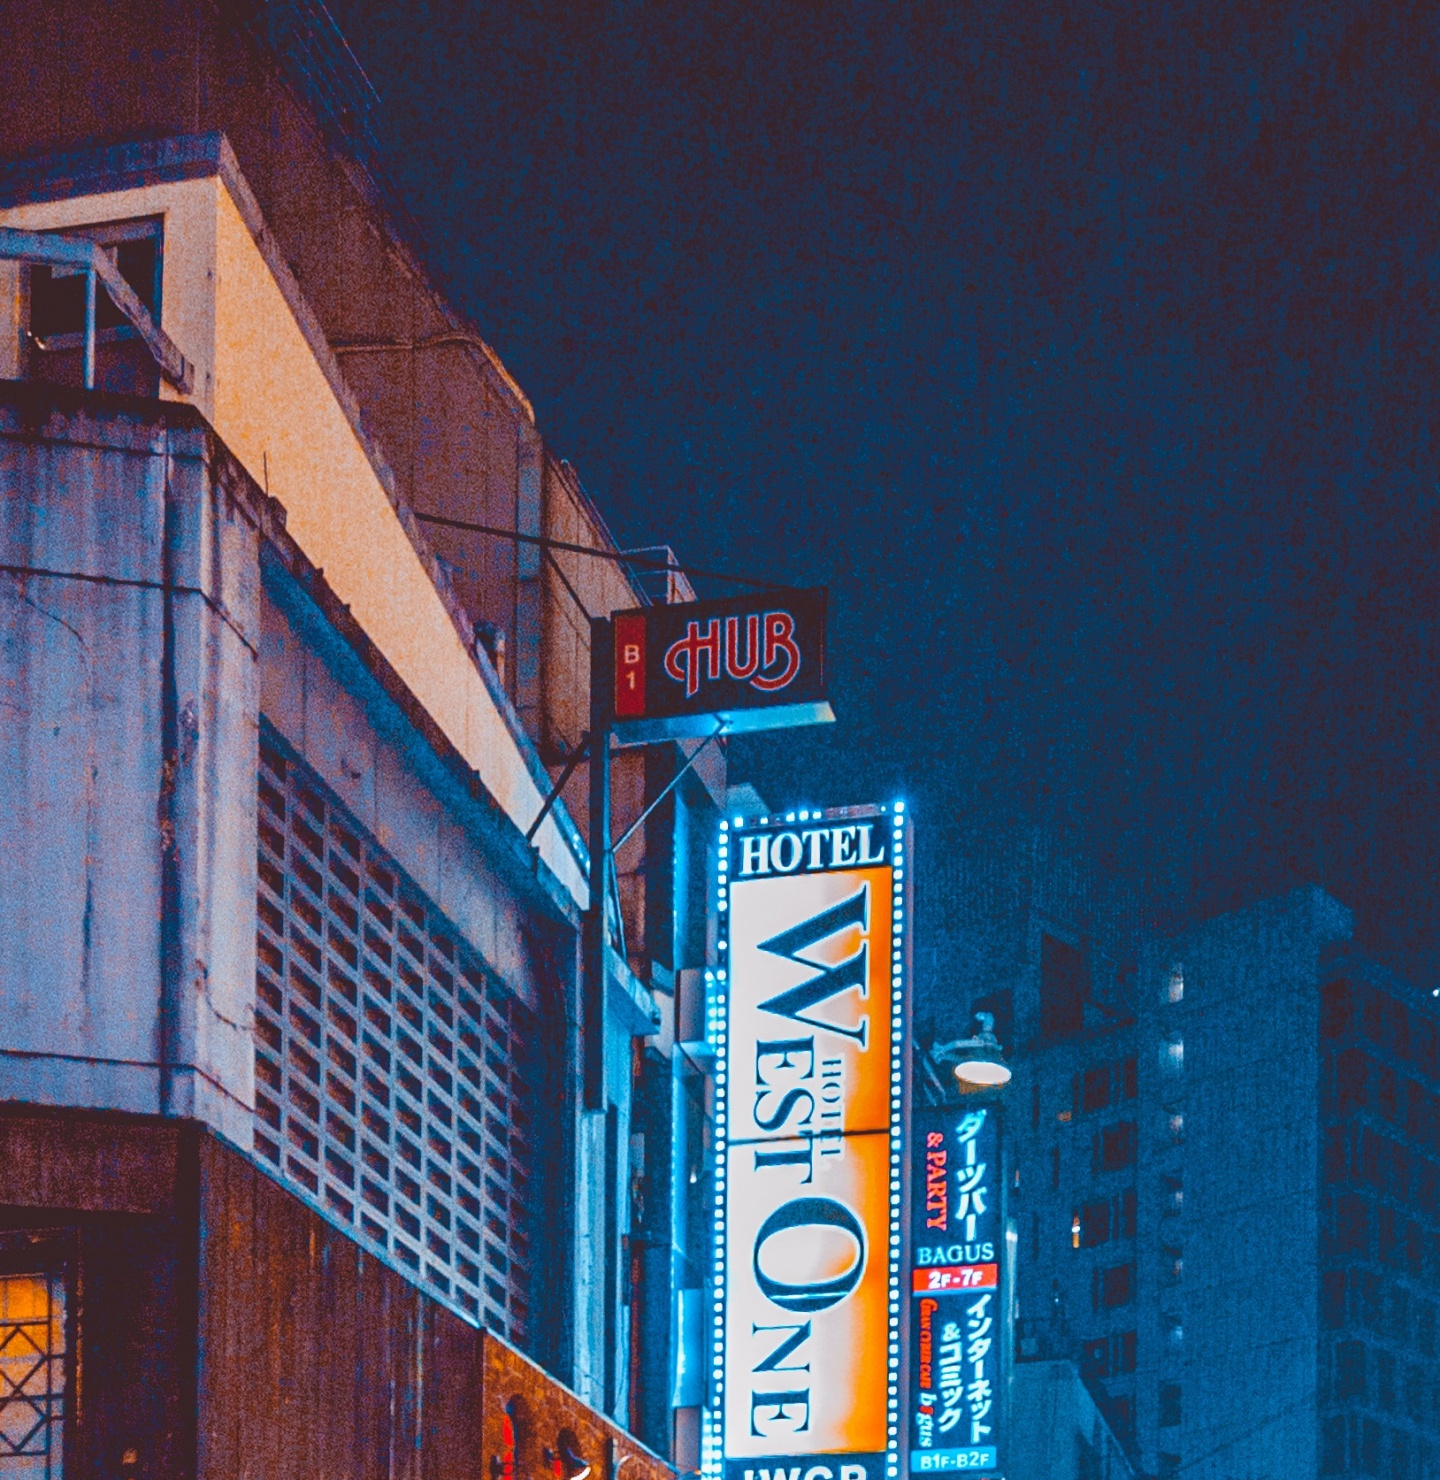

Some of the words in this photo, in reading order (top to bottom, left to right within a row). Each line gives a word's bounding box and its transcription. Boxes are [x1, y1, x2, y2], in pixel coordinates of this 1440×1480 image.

[624, 644, 641, 690] B1
[664, 611, 801, 698] HUB
[739, 824, 884, 876] HOTEL
[926, 1132, 943, 1149] &
[926, 1150, 947, 1232] PARTY
[955, 1109, 987, 1242] ダーツバー
[917, 1242, 995, 1265] BAGUS
[966, 1293, 992, 1444] インターネット
